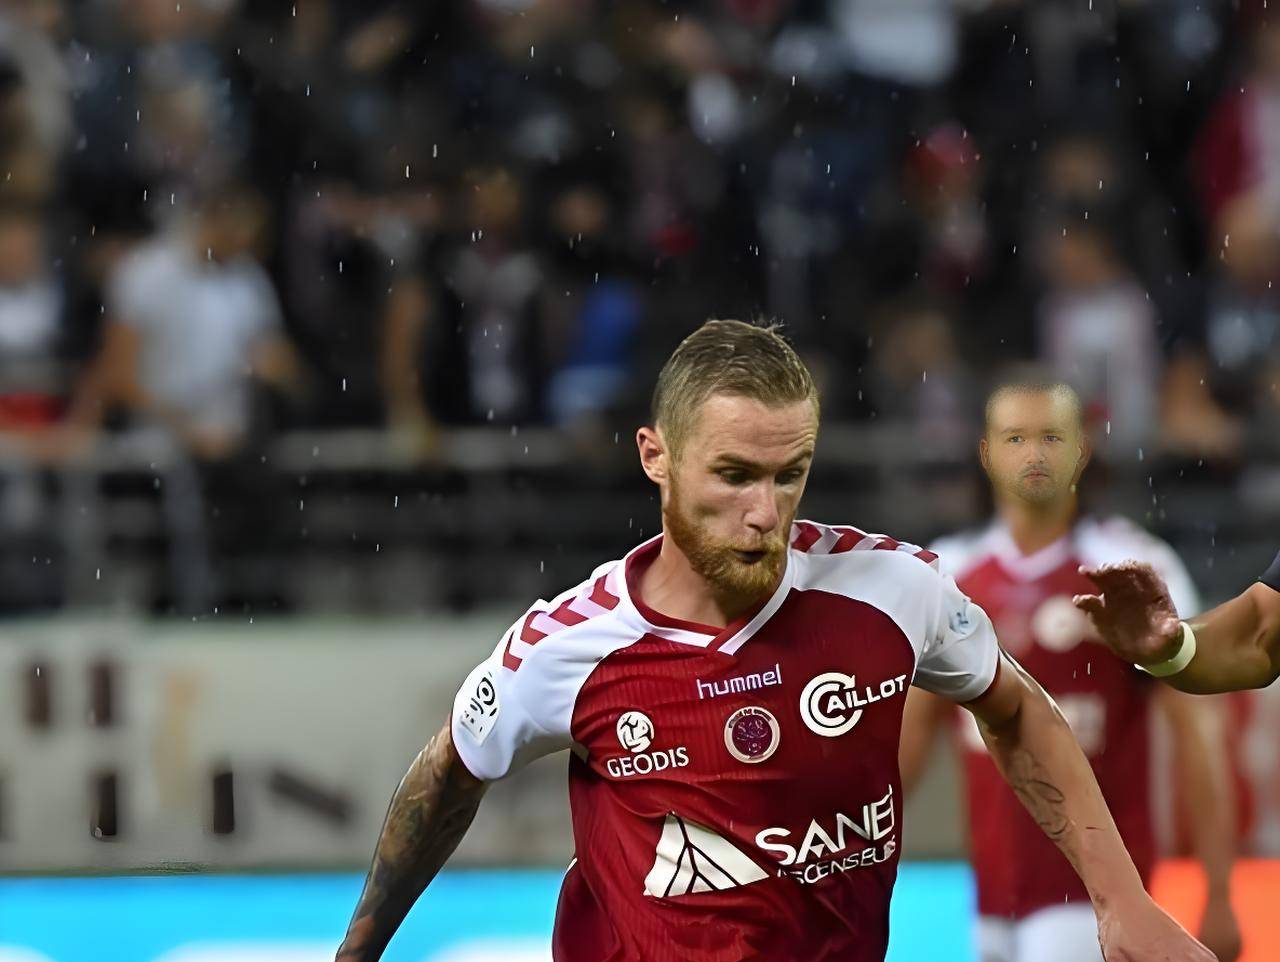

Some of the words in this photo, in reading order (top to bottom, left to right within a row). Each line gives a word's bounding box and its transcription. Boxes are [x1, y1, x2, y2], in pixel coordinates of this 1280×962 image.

[697, 663, 783, 699] hummel
[607, 746, 690, 777] GEODIS
[755, 784, 895, 865] SANE
